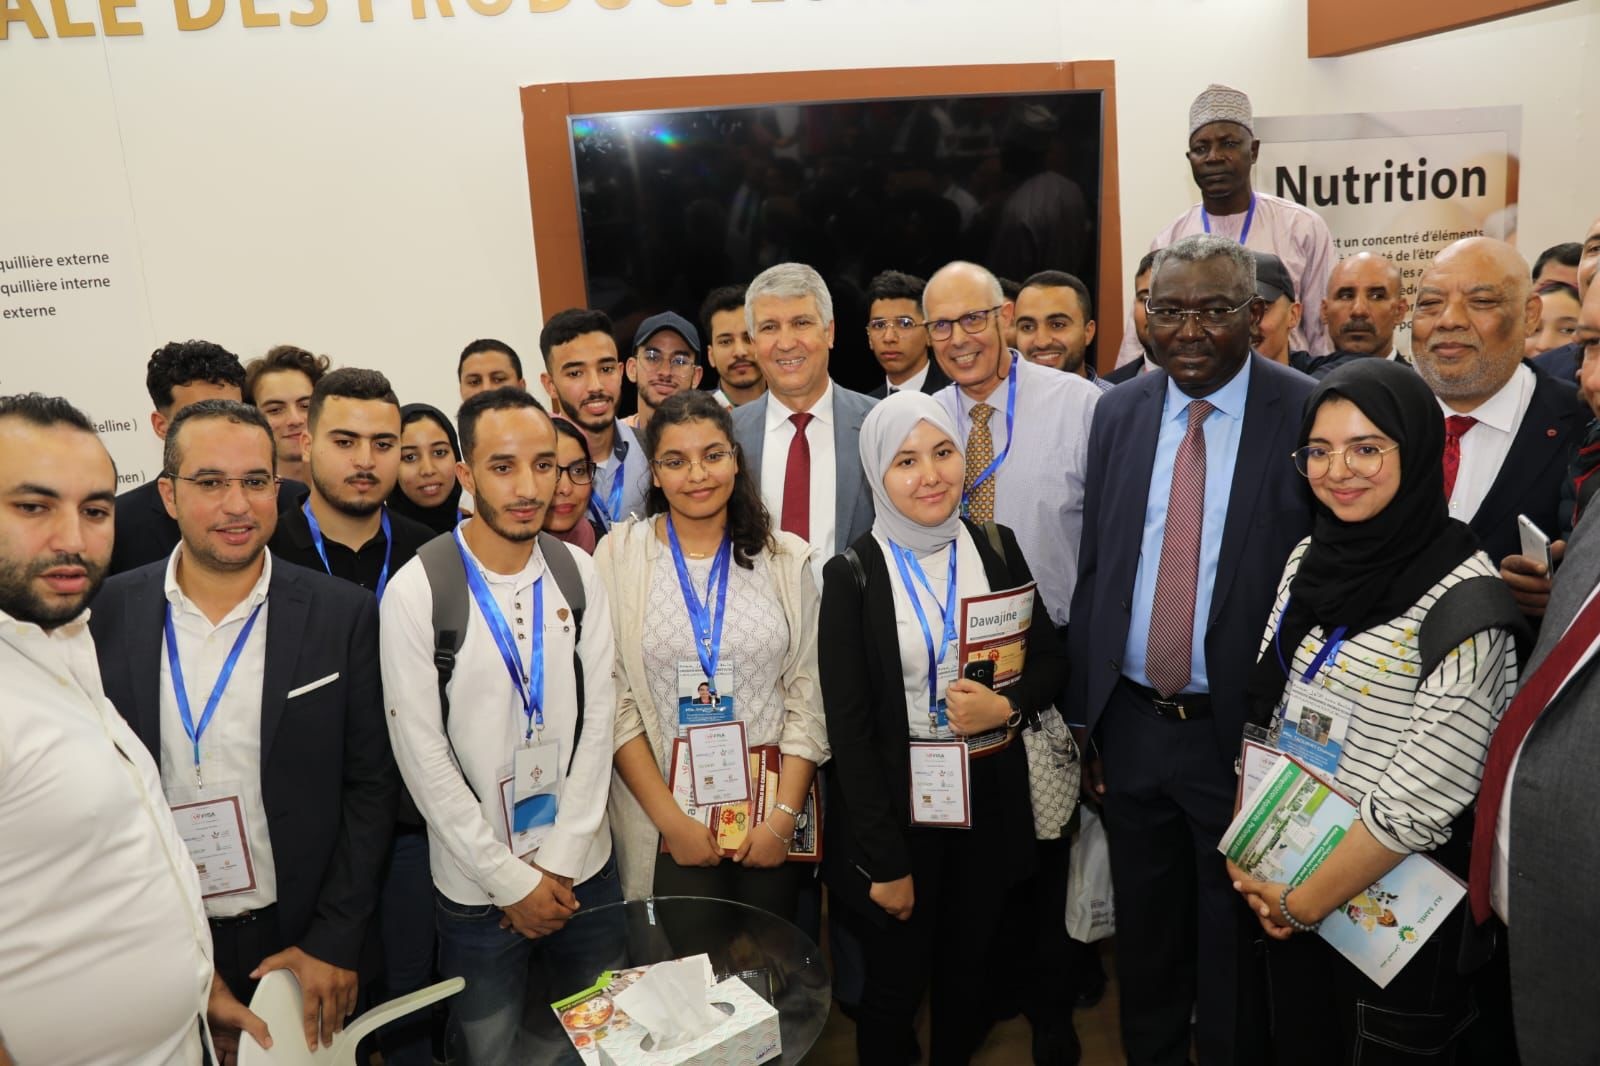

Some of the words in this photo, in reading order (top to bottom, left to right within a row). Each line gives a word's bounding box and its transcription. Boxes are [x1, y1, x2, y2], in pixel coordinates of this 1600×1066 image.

[1275, 157, 1486, 207] Nutrition
[1344, 238, 1359, 248] un
[1362, 231, 1419, 247] concentré
[57, 254, 110, 266] externe
[1396, 250, 1410, 261] de
[0, 279, 58, 297] quillière
[60, 277, 111, 290] interne
[3, 306, 57, 319] externe
[969, 610, 1018, 628] Dawajine
